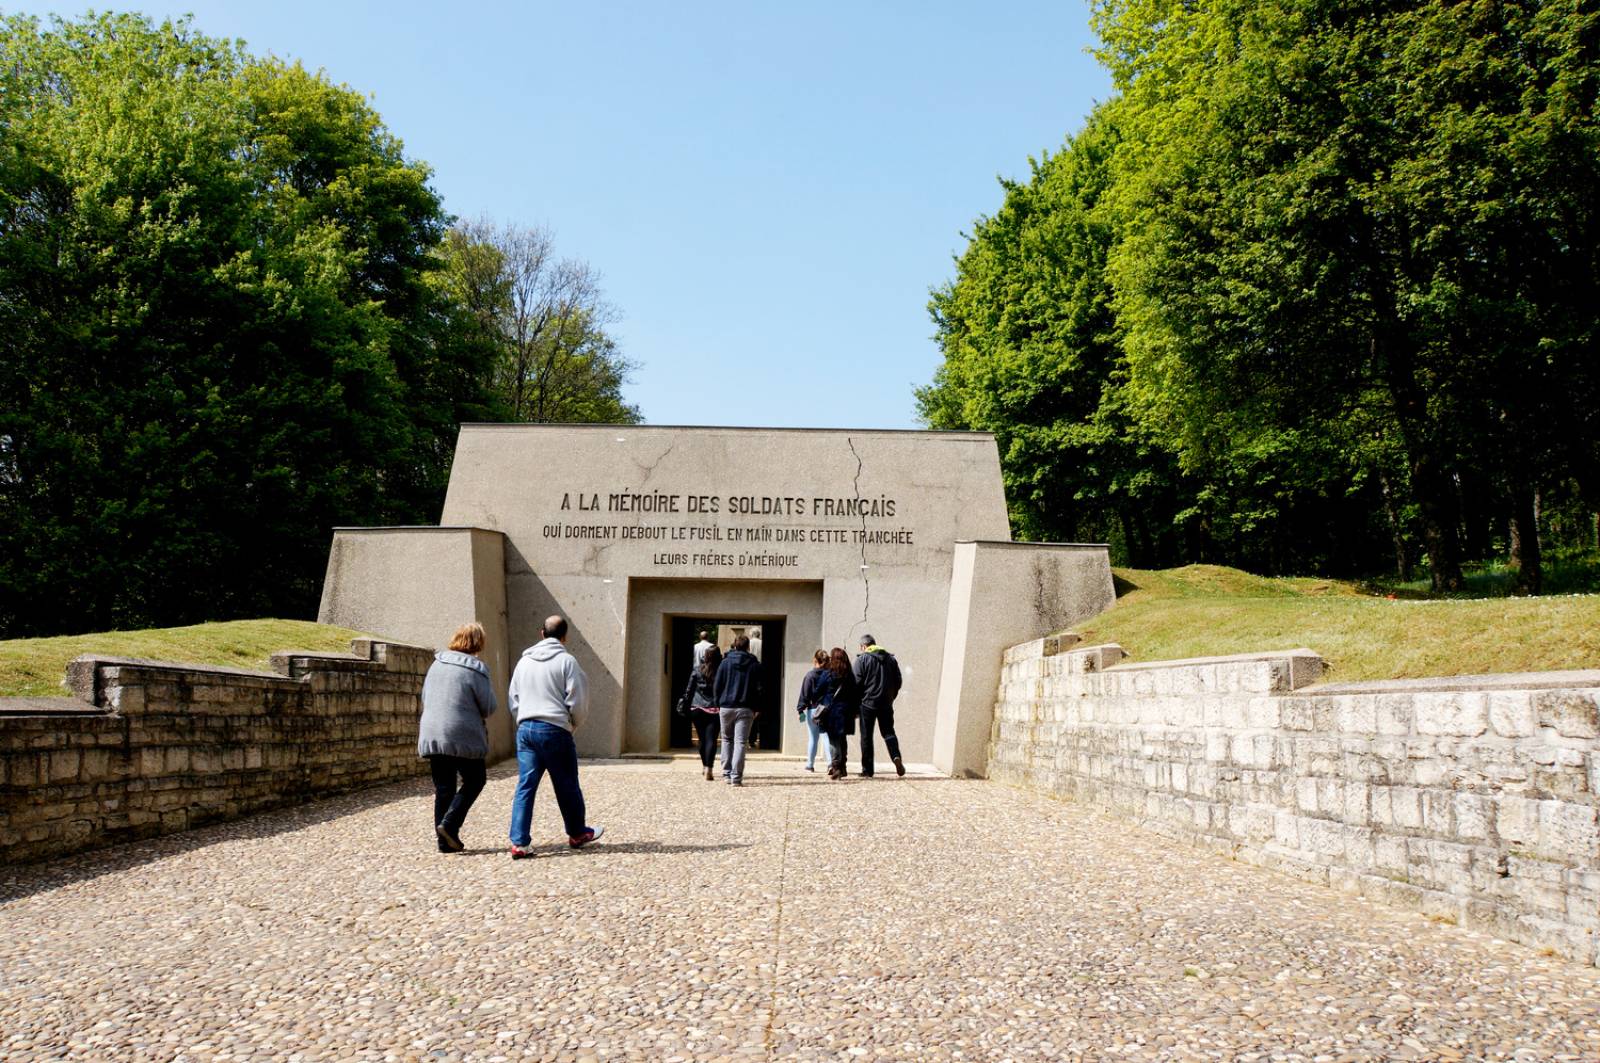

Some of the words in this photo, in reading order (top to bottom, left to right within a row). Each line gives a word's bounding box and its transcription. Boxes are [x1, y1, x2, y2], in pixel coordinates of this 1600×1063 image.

[561, 493, 571, 510] A
[579, 493, 600, 511] LA
[688, 495, 720, 513] DES
[728, 496, 805, 515] SOLDATS
[565, 525, 617, 539] DORMENT
[622, 526, 668, 539] DEBOUT
[671, 527, 686, 540] LE
[690, 524, 723, 540] FUSIL
[728, 528, 742, 541] EN
[746, 525, 772, 541] MAIN
[776, 529, 805, 542] DANS
[810, 530, 847, 542] CETTE
[852, 527, 913, 544] TRANCHÉE
[654, 554, 688, 564] LEURS
